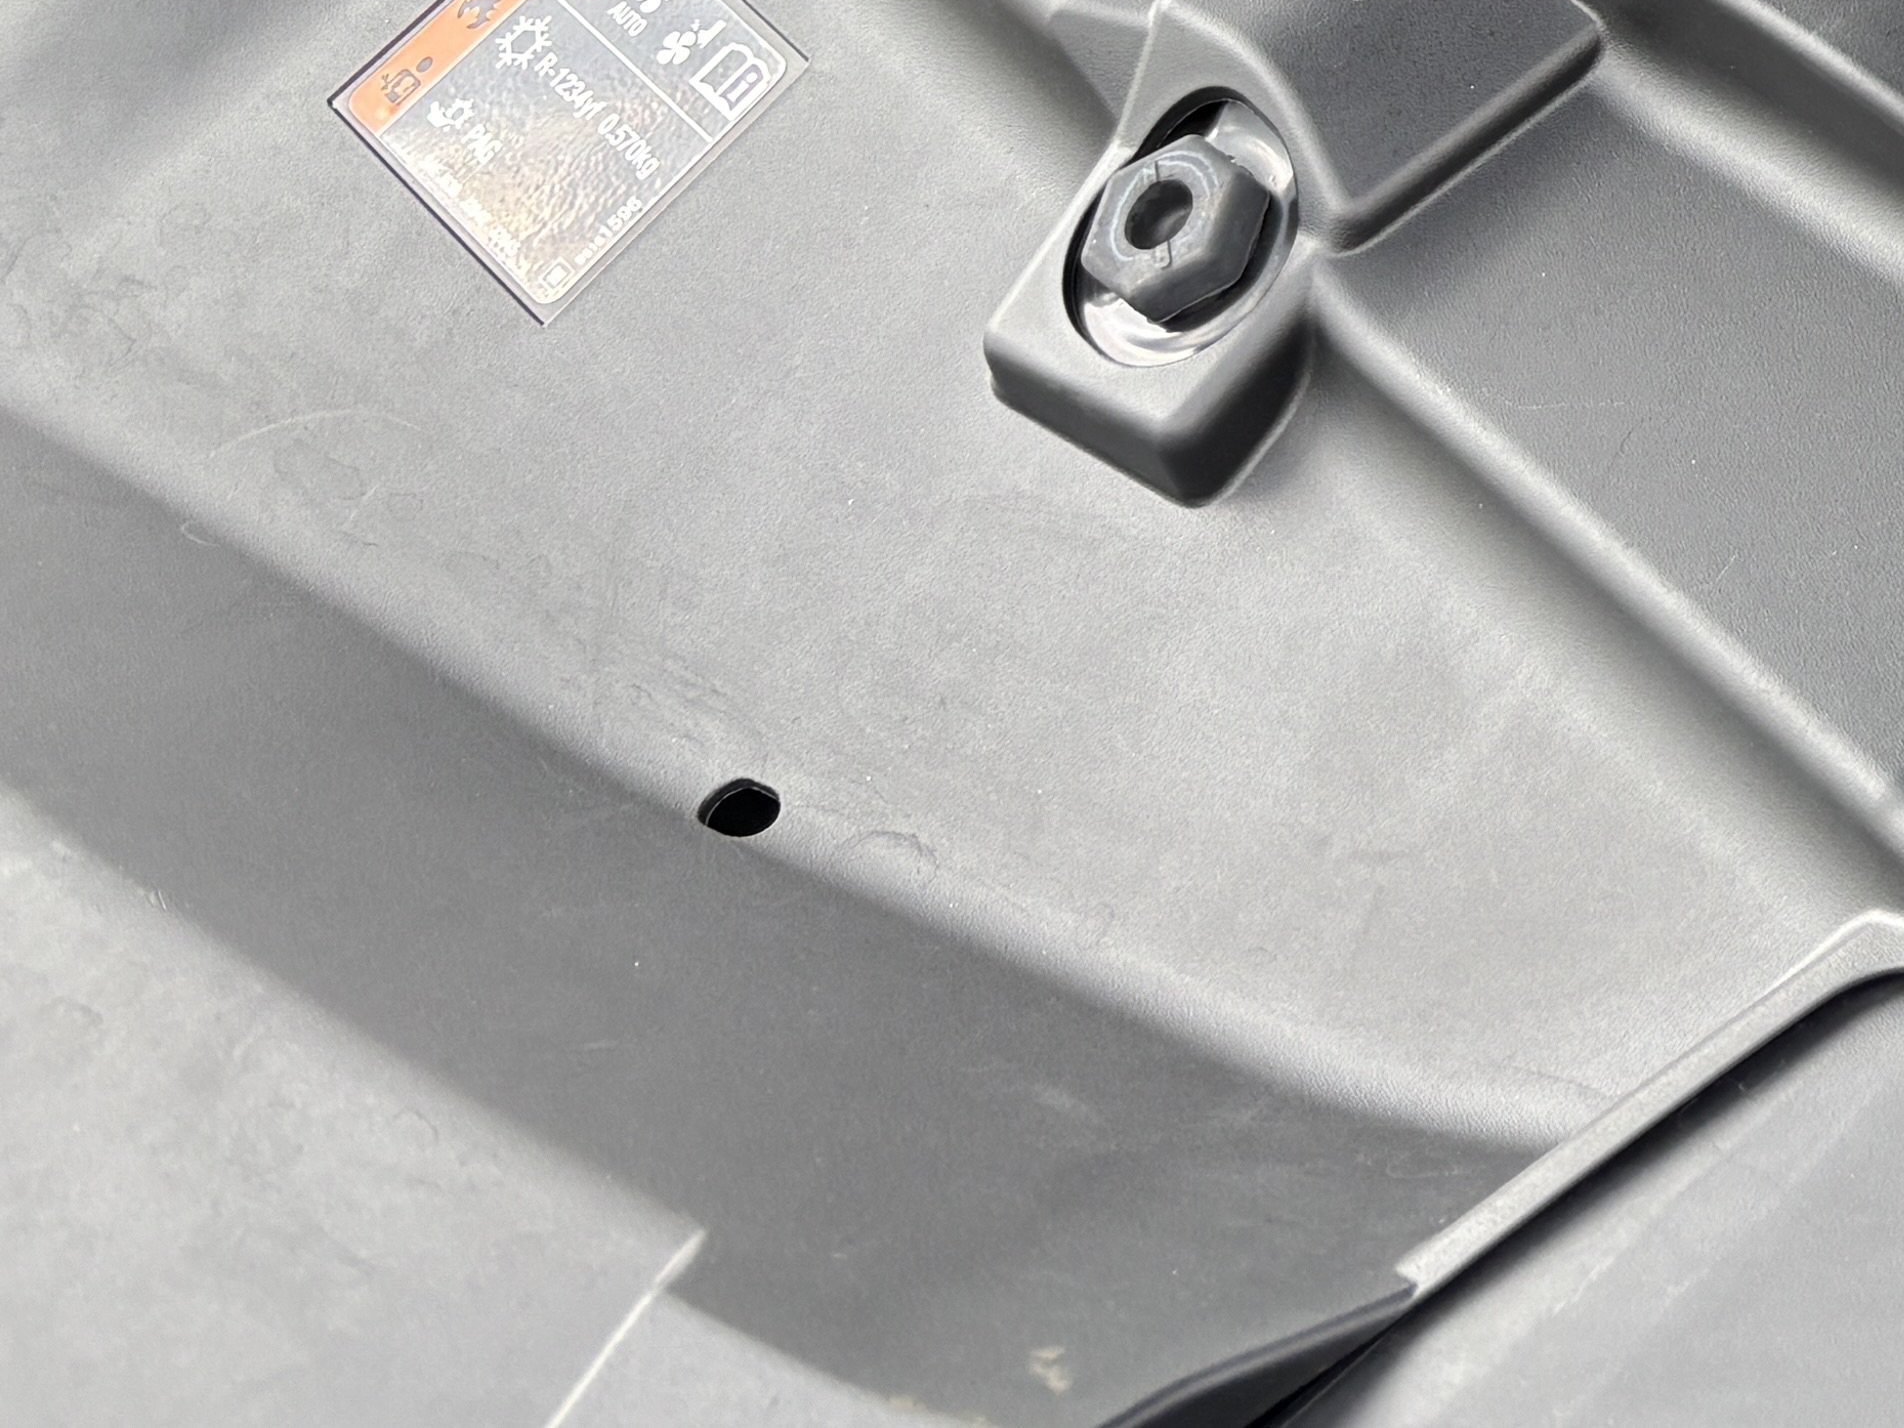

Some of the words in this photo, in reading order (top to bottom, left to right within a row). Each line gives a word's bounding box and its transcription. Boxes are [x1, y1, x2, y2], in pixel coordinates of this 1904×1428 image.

[607, 0, 649, 39] AUTO
[534, 52, 607, 123] R-1234yf
[597, 106, 661, 182] 0.570kg
[461, 122, 504, 165] PAG
